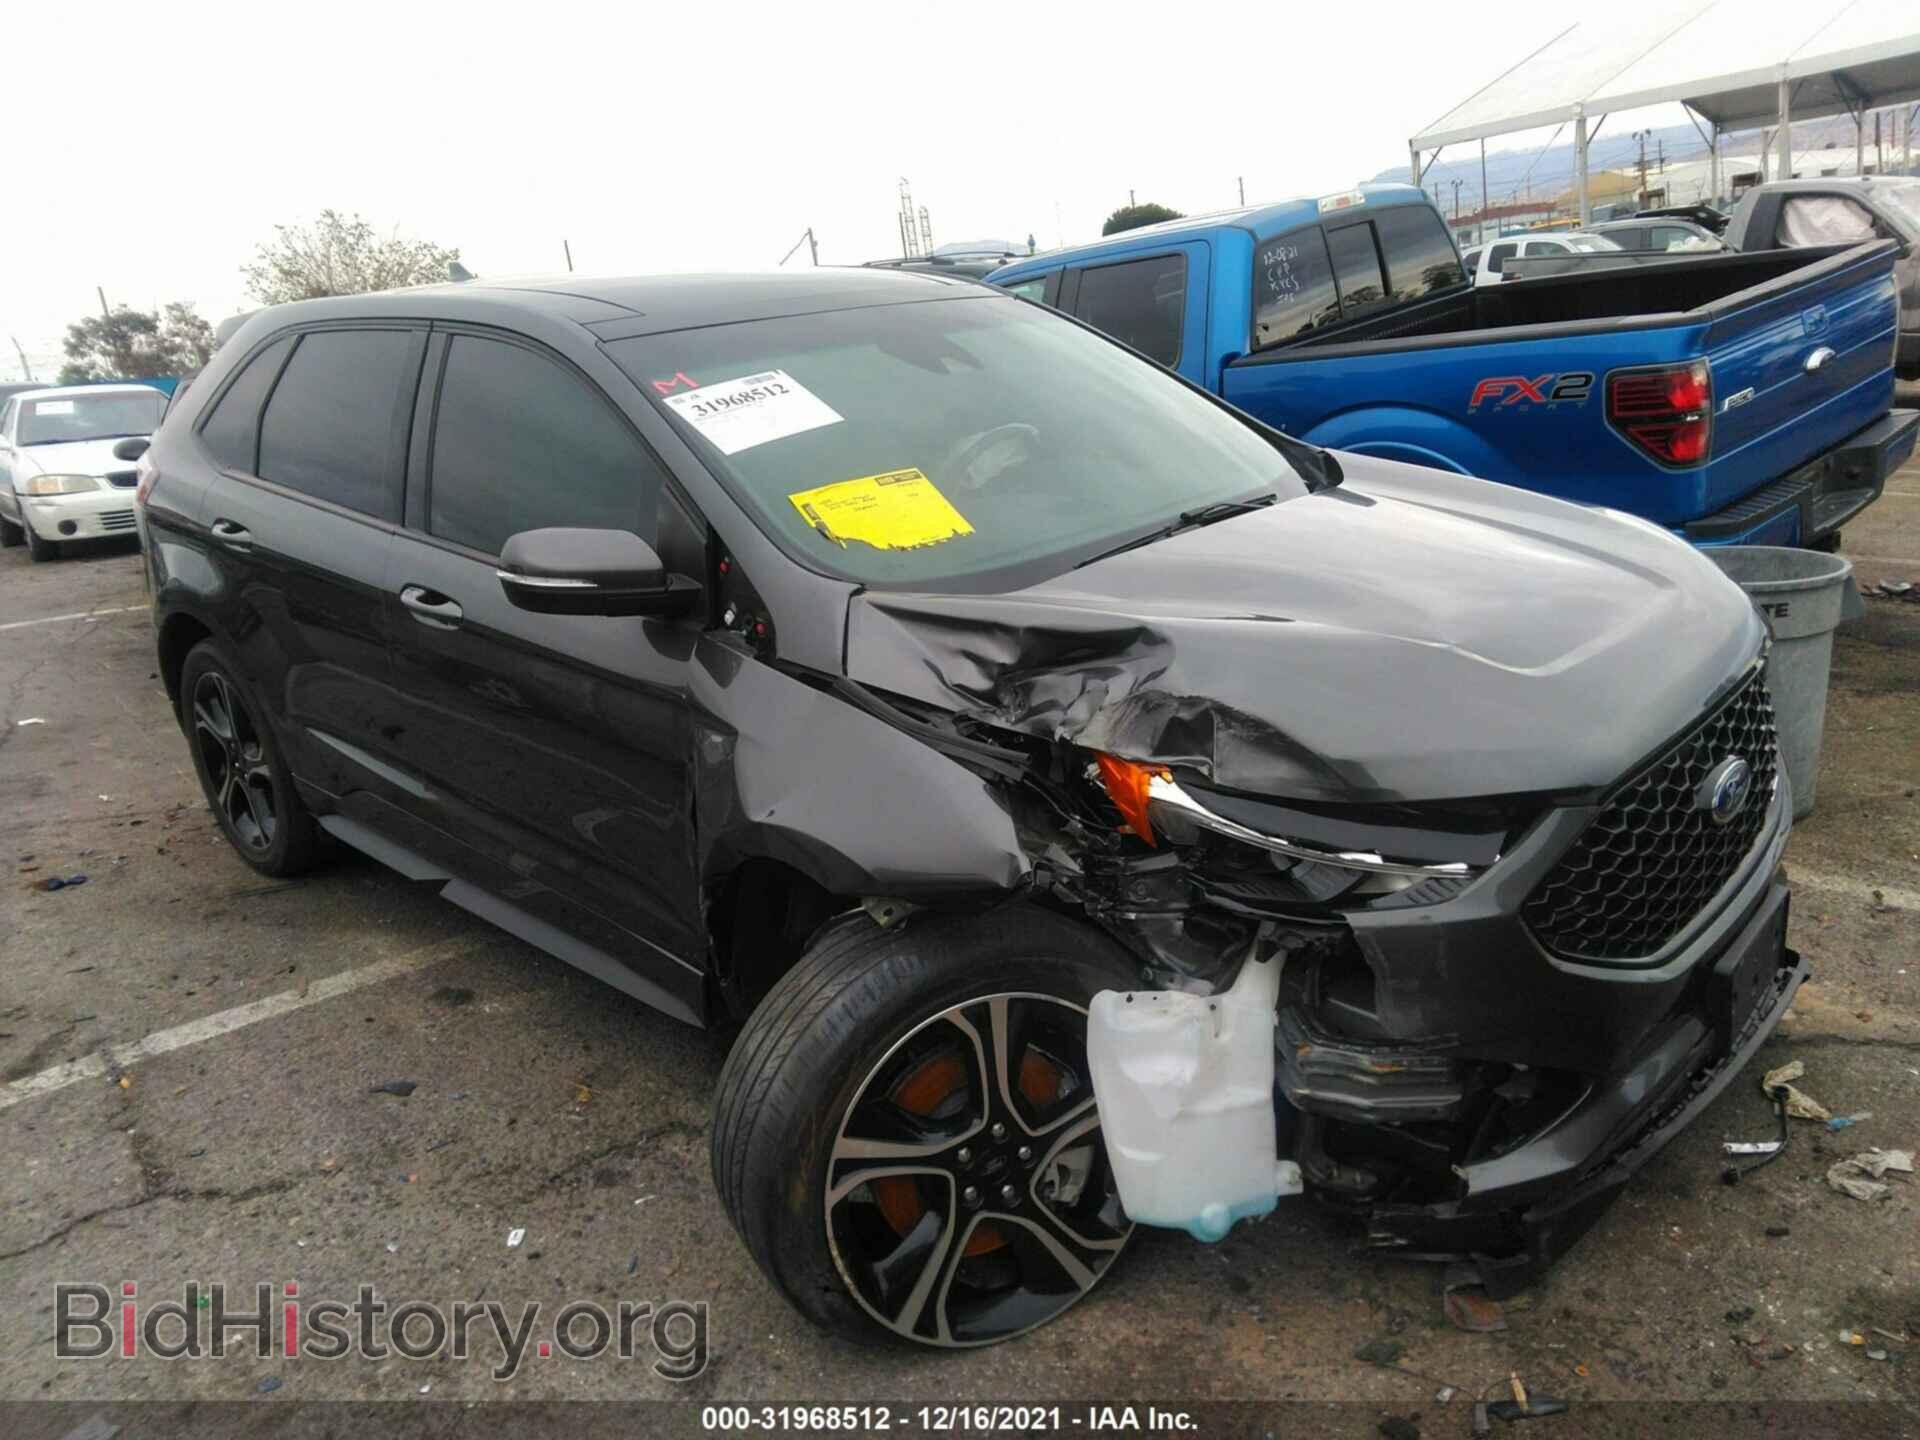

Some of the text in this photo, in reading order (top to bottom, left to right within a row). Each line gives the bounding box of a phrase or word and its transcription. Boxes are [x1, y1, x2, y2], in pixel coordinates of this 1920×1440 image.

[652, 371, 700, 394] M
[1469, 370, 1595, 407] FX2
[691, 383, 790, 417] 31968512
